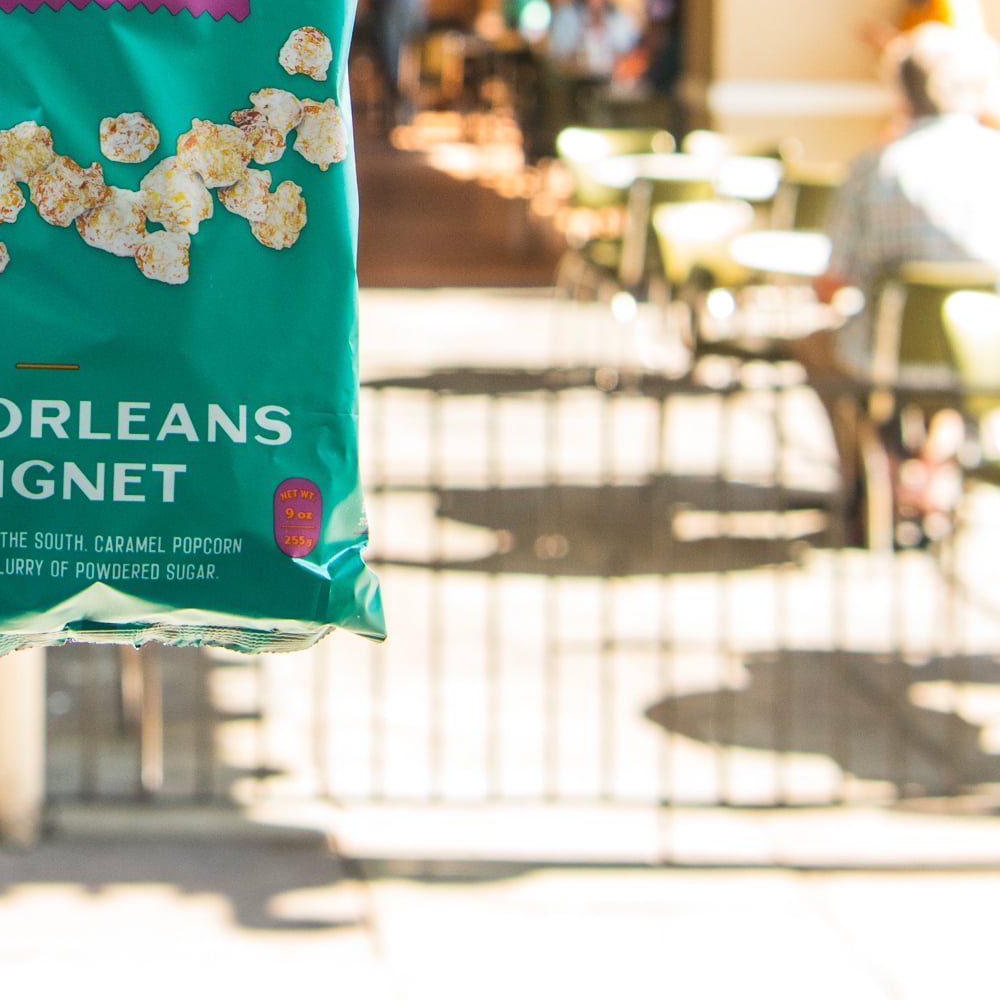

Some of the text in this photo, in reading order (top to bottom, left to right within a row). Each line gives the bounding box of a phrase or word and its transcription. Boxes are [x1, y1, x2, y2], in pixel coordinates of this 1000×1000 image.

[280, 489, 298, 501] NET
[285, 507, 313, 520] 9 oz
[0, 531, 28, 549] THE
[34, 531, 88, 552] SOUTH.
[94, 535, 166, 553] CARAMEL
[173, 536, 242, 555] POPCORN
[284, 535, 313, 549] 255g
[50, 560, 69, 578] OF
[75, 562, 160, 580] POWDERED
[166, 563, 219, 580] SUGAR.
